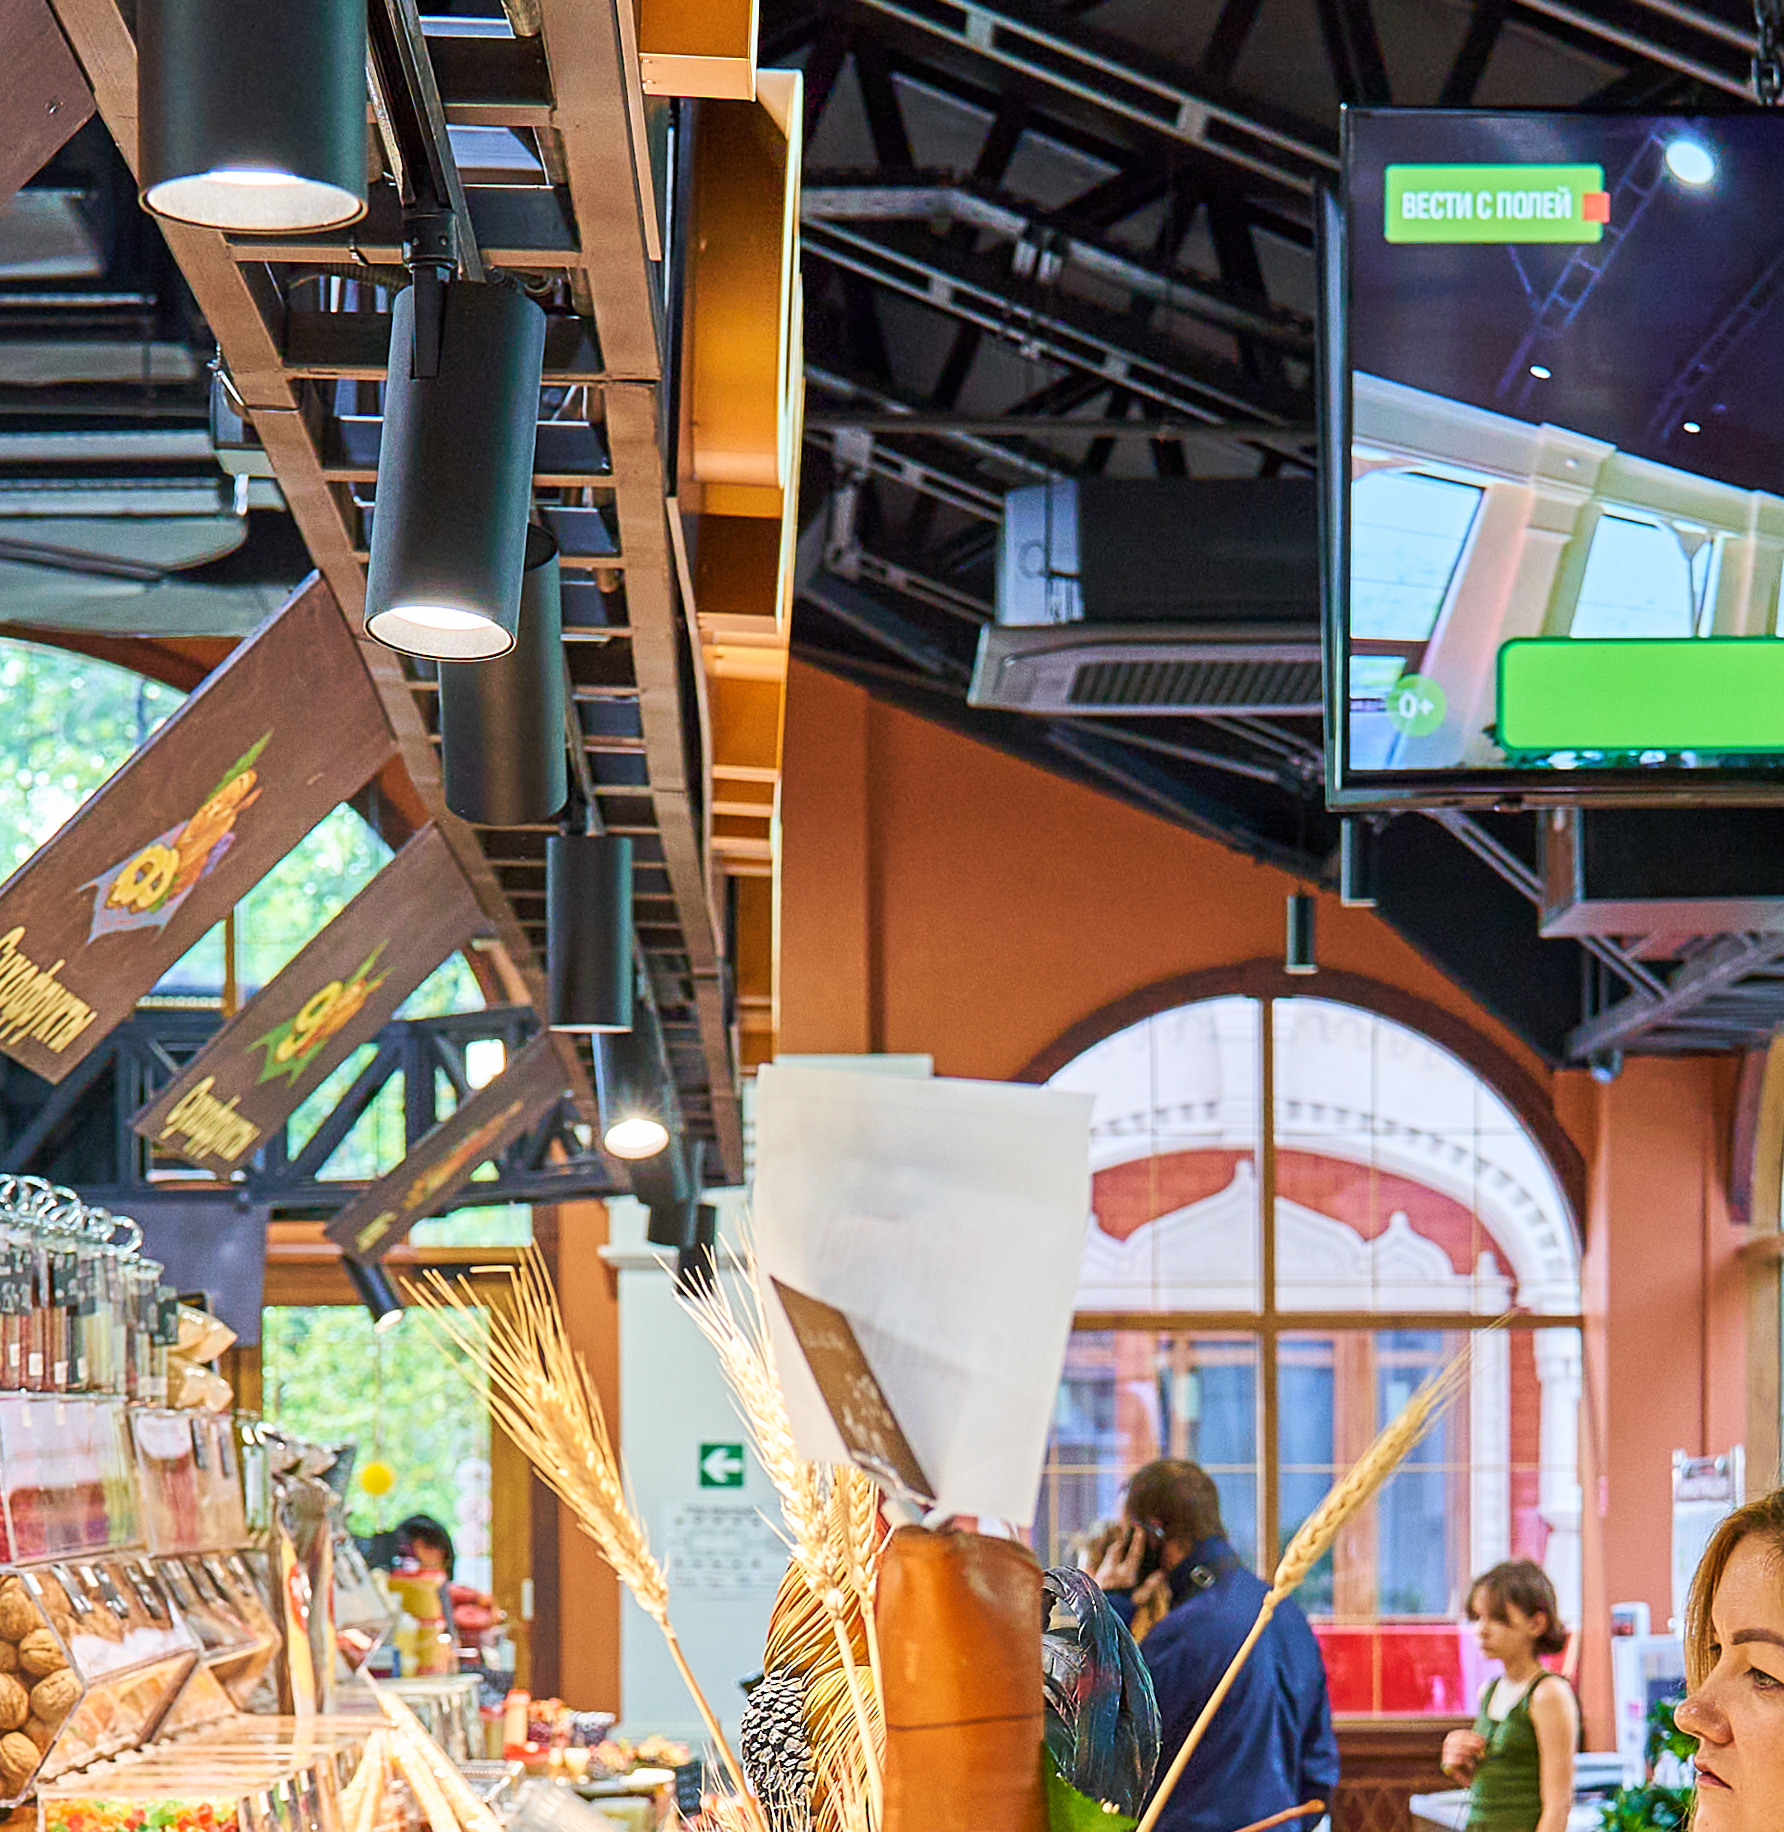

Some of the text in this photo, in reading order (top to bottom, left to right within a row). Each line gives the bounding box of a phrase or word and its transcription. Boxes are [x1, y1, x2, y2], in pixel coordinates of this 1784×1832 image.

[1402, 185, 1572, 220] ВЕСТИ С ПОЛЕЙ
[1398, 691, 1434, 719] 0+
